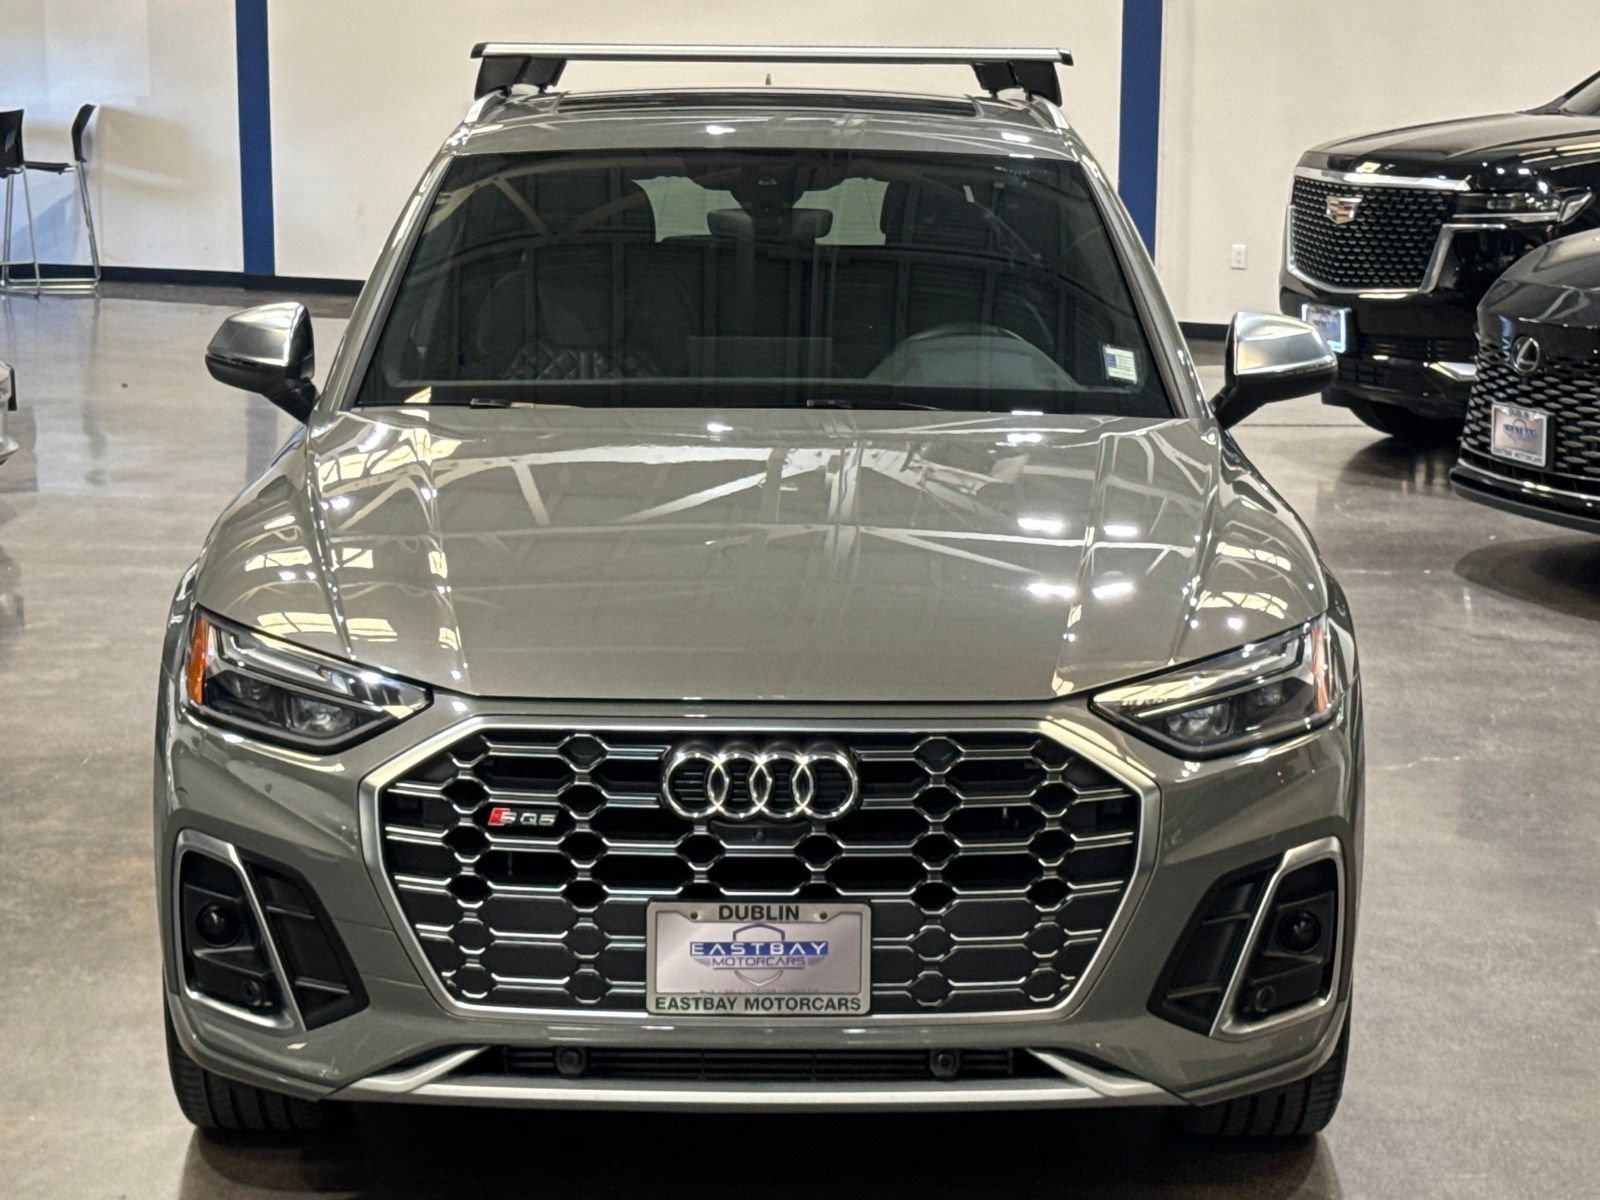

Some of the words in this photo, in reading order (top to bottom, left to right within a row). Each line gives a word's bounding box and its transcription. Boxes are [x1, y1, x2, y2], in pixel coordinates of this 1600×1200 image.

[718, 905, 800, 921] DUBLIN
[691, 942, 827, 955] EASTBAY
[712, 956, 806, 967] MOTORCARS
[655, 997, 737, 1011] EASTBAY
[744, 997, 861, 1011] MOTORCARS
